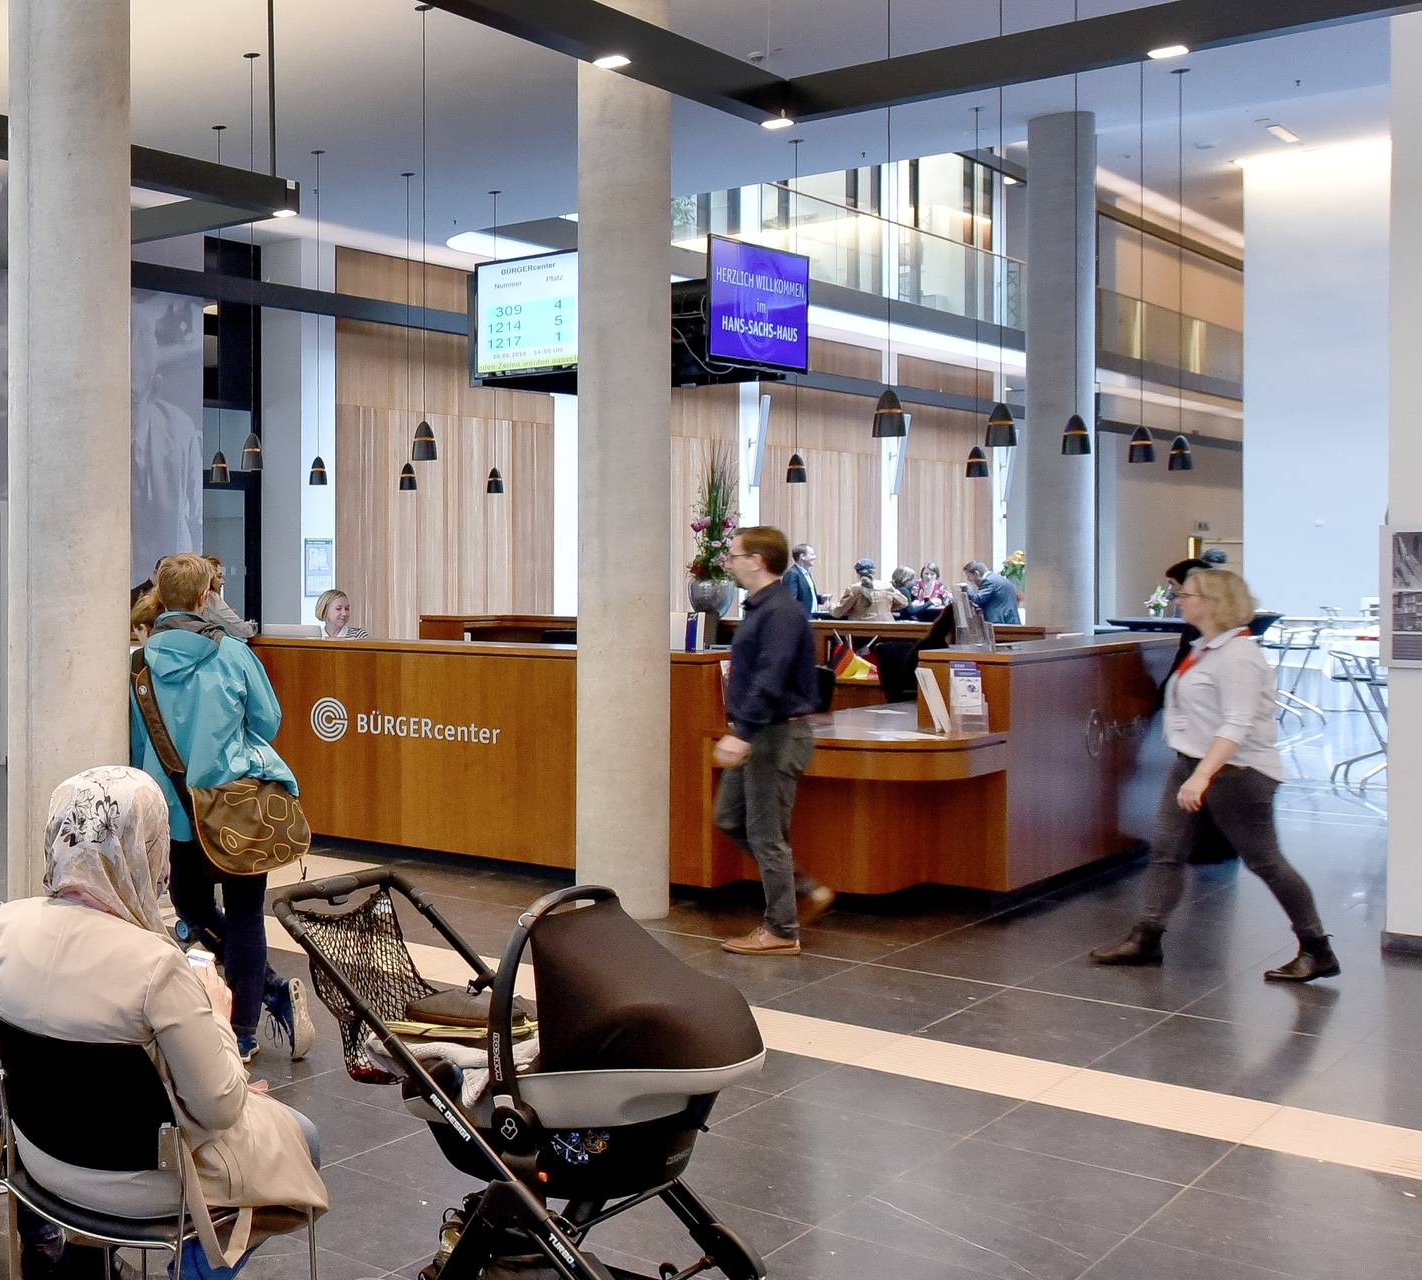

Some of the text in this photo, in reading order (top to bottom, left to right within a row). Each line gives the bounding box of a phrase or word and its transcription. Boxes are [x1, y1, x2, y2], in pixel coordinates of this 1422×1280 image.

[501, 262, 556, 275] BÜRGERcenter
[494, 281, 522, 289] Nummer
[716, 265, 805, 298] HERZLICH WILLKOMMEN
[496, 300, 562, 317] 309 4
[757, 297, 766, 313] im
[488, 315, 563, 334] 1214 5
[721, 315, 798, 342] HANS-SACHS-HAUS
[488, 332, 561, 349] 1217 1
[357, 710, 501, 744] BÜRGERcenter
[429, 1093, 471, 1142] ABC DESIGN
[549, 1233, 574, 1264] TURBO
